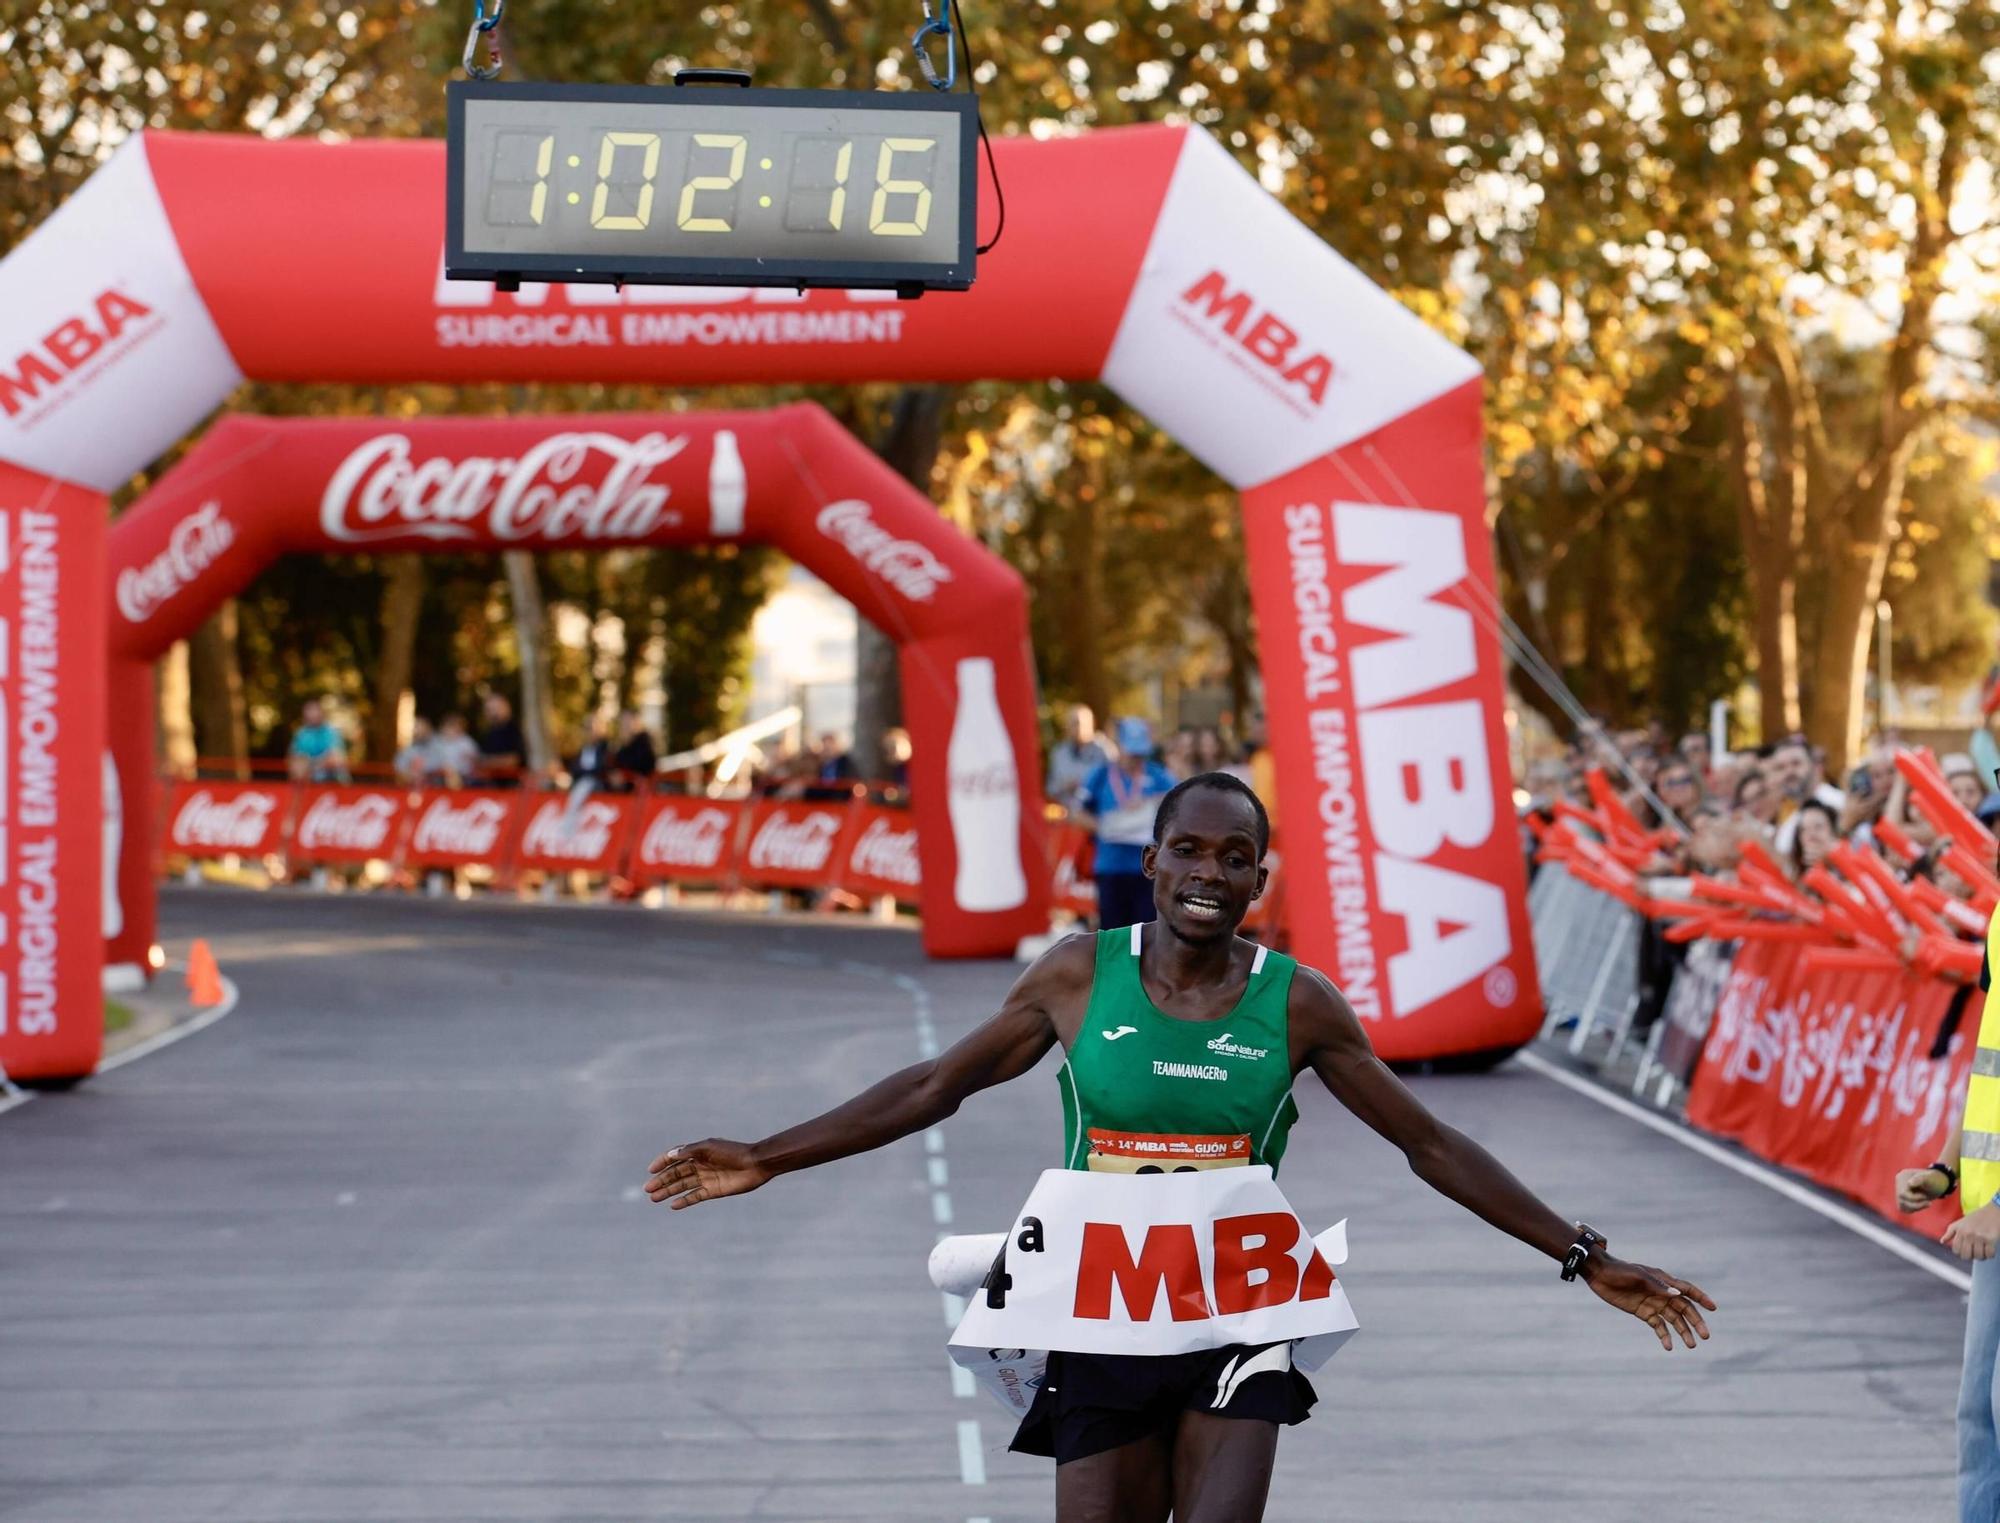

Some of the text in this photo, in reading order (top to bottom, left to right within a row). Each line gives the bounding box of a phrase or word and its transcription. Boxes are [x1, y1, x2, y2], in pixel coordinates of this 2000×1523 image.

[529, 132, 937, 236] 1:02:16
[0, 288, 152, 418] MBA
[435, 310, 905, 347] SURGICAL EMPOWERMENT
[1183, 269, 1334, 407] MBA
[319, 433, 690, 541] Coca-Cola
[18, 510, 58, 1036] SURGICAL EMPOWERMENT
[1285, 503, 1380, 1022] SURGICAL EMPOWERMENT
[1330, 501, 1512, 1018] MBA
[1152, 1060, 1228, 1081] TEAMMANAGER10
[1135, 1141, 1167, 1152] MBA
[1194, 1142, 1228, 1154] GIJÓN
